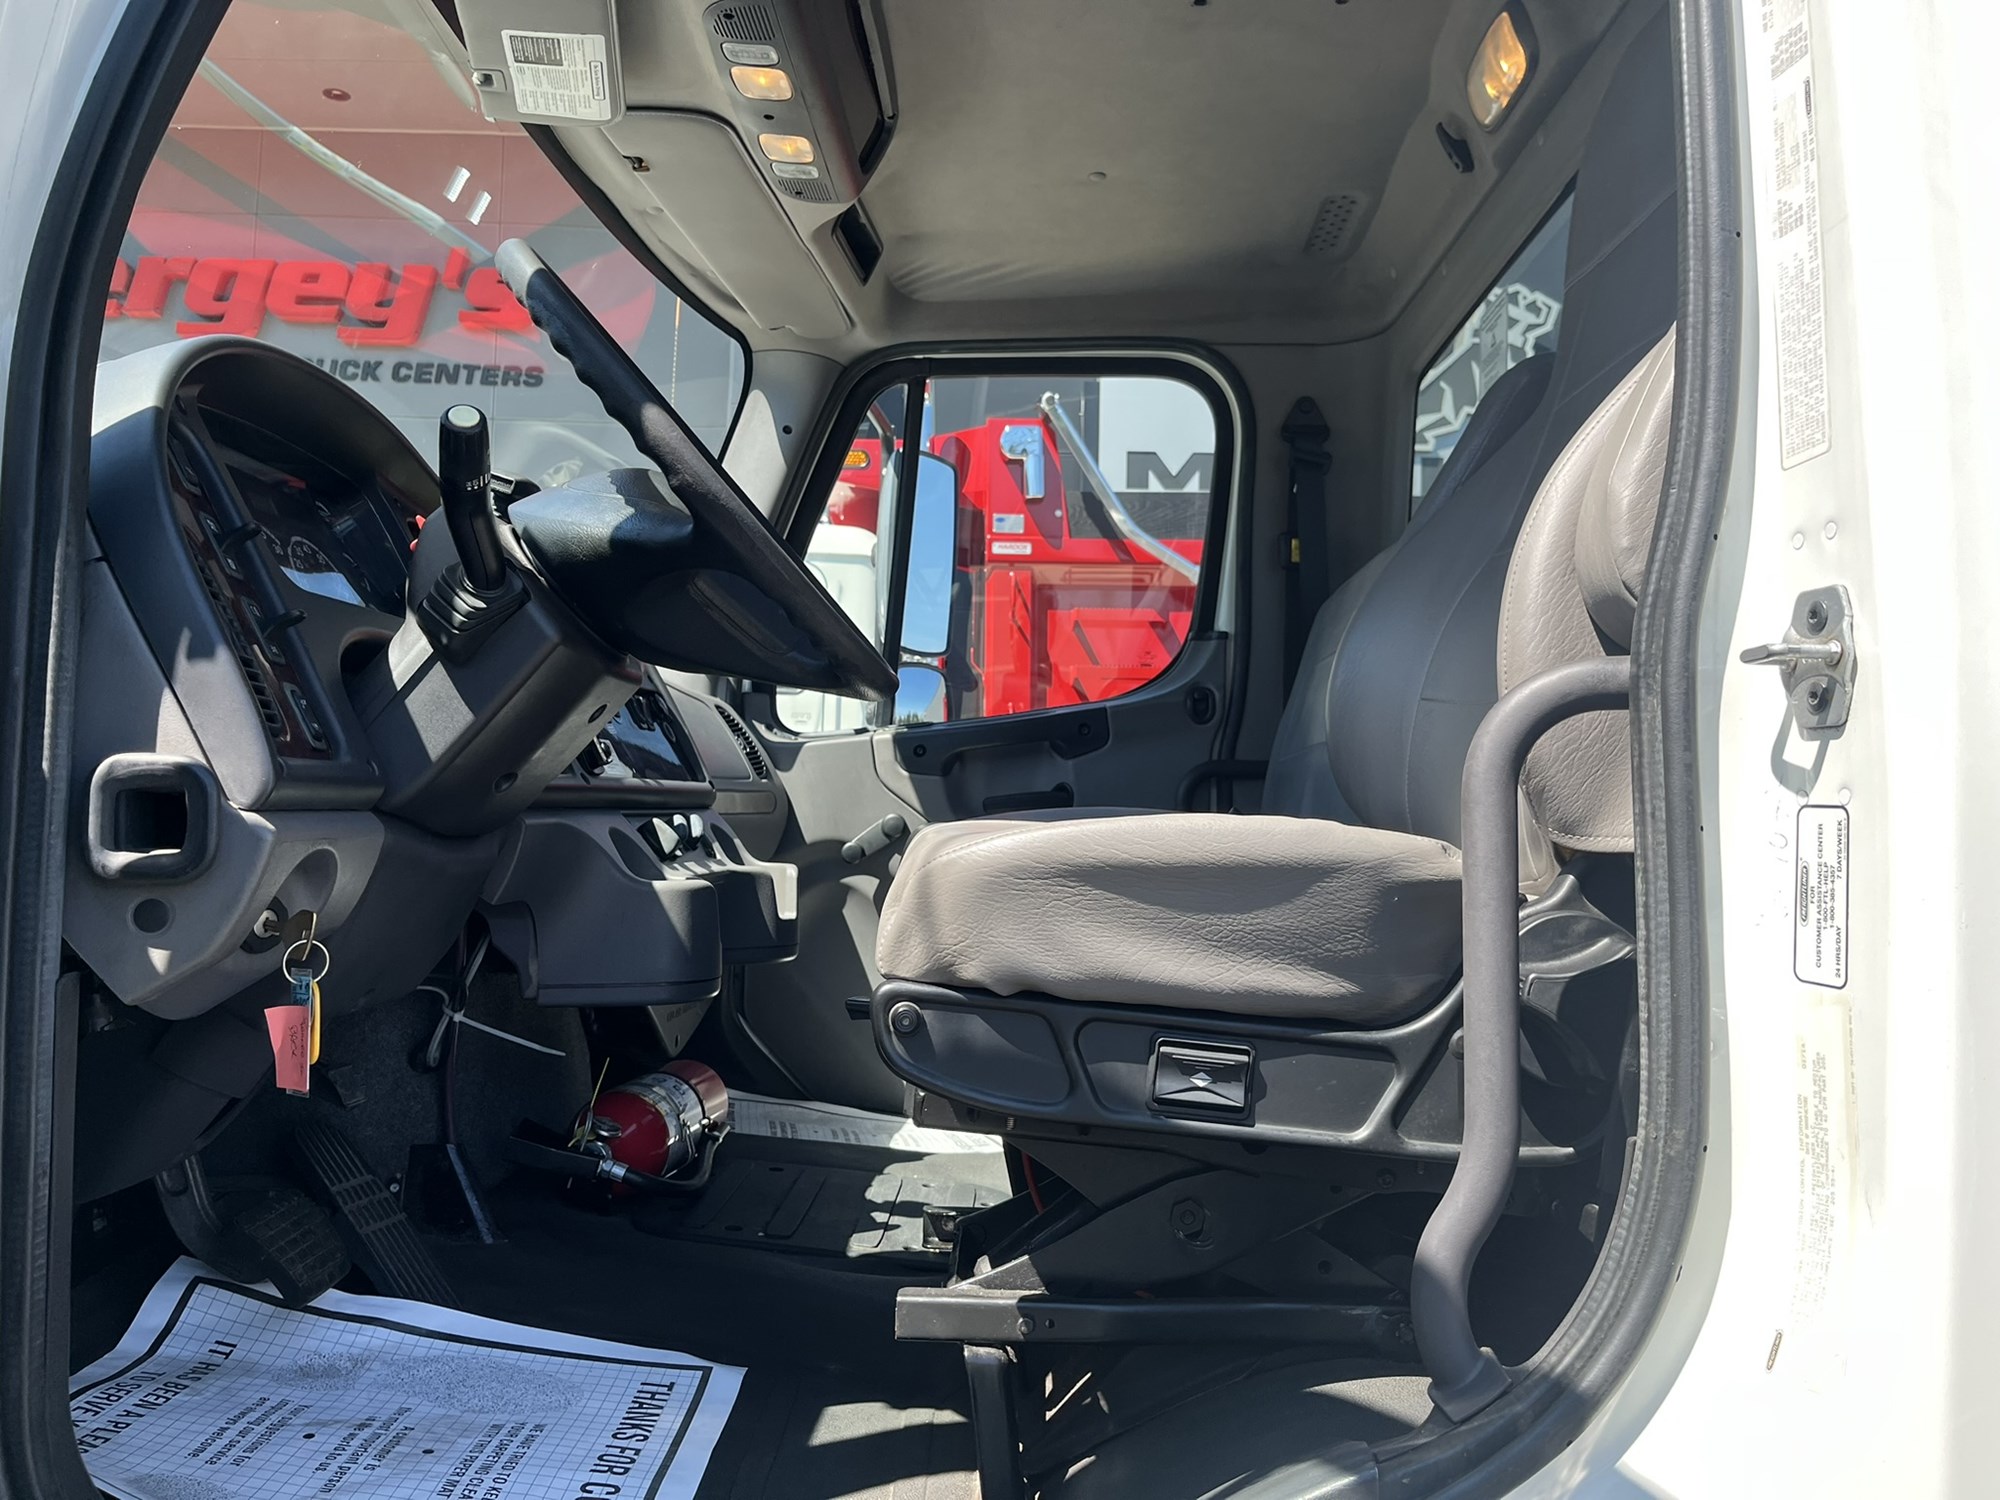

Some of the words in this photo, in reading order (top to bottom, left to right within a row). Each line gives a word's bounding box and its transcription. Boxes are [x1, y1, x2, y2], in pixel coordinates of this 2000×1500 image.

[391, 361, 545, 388] CENTERS
[1835, 968, 1841, 978] 24
[208, 1340, 238, 1360] IT
[129, 1370, 166, 1383] TO
[175, 1362, 222, 1382] HAS
[71, 1382, 142, 1417] SERVE
[132, 1382, 190, 1410] BEEN
[116, 1409, 146, 1418] A
[611, 1382, 676, 1442] THANKS
[184, 1426, 230, 1458] welcome.
[204, 1438, 241, 1466] service
[334, 1432, 360, 1452] world
[230, 1455, 252, 1466] for
[324, 1452, 343, 1461] to
[450, 1454, 480, 1478] PAPER
[501, 1451, 528, 1471] TRIED
[589, 1444, 642, 1476] FOR
[364, 1463, 381, 1472] is
[319, 1465, 352, 1494] person
[492, 1472, 512, 1485] TO
[436, 1478, 460, 1500] MAT
[574, 1482, 621, 1500] C
